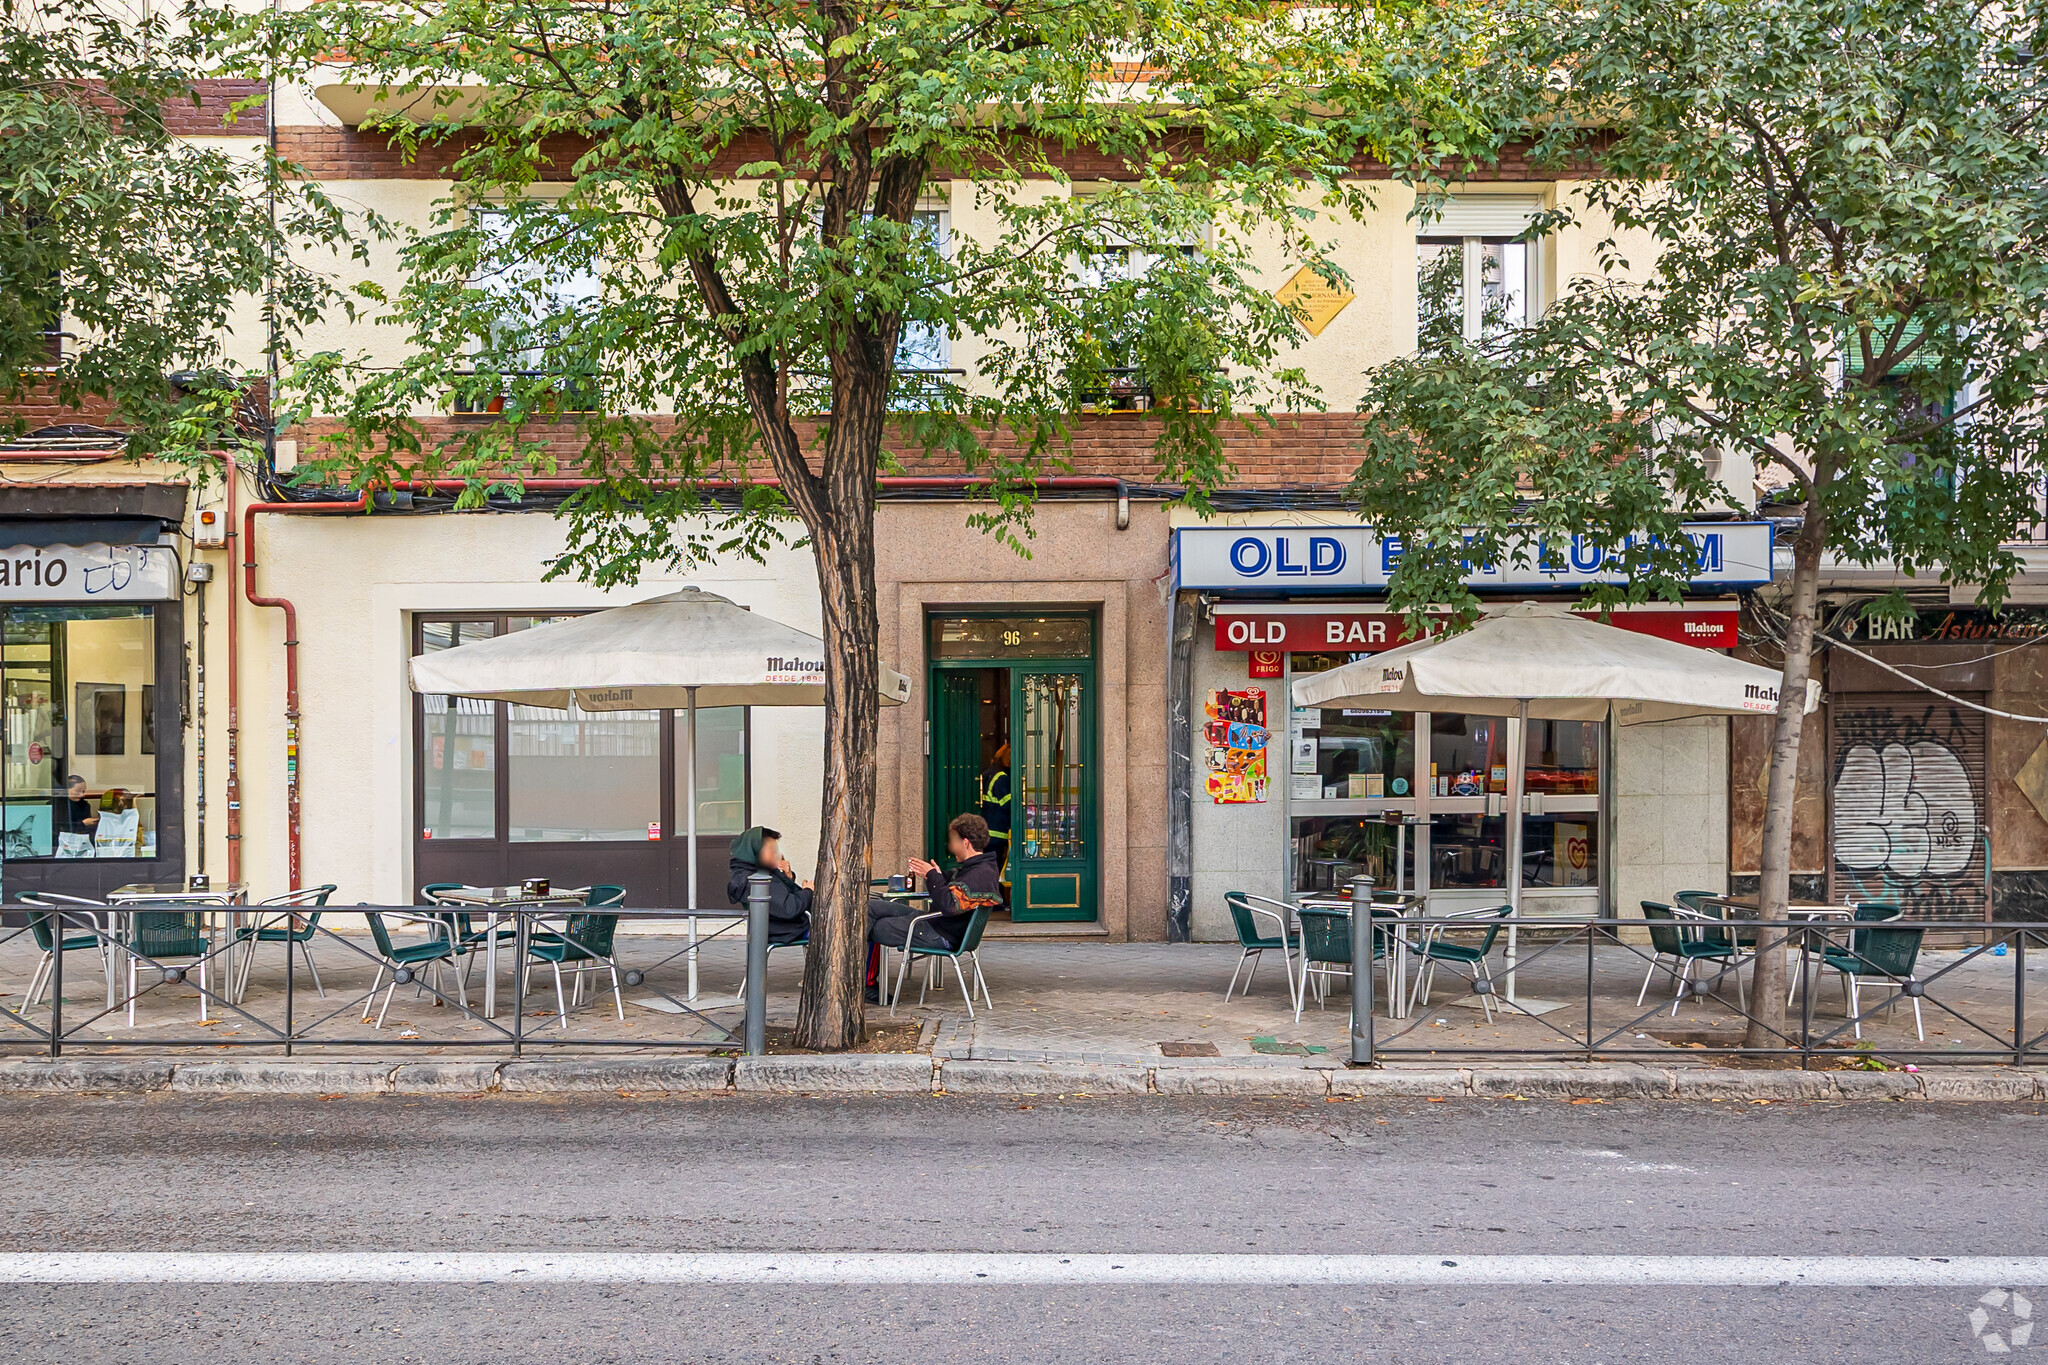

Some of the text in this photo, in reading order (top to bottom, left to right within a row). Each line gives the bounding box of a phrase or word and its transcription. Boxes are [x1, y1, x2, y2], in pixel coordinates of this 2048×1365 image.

[1230, 537, 1347, 578] OLD
[1381, 536, 1497, 576] BR
[1227, 620, 1387, 645] OLD BAR
[1684, 622, 1725, 633] Mahou
[1868, 612, 1914, 640] BAR
[1003, 630, 1021, 646] 96
[766, 656, 825, 672] Mahou
[1256, 665, 1280, 673] FRIGO
[1744, 683, 1780, 702] Mah
[1743, 701, 1771, 712] DESDE
